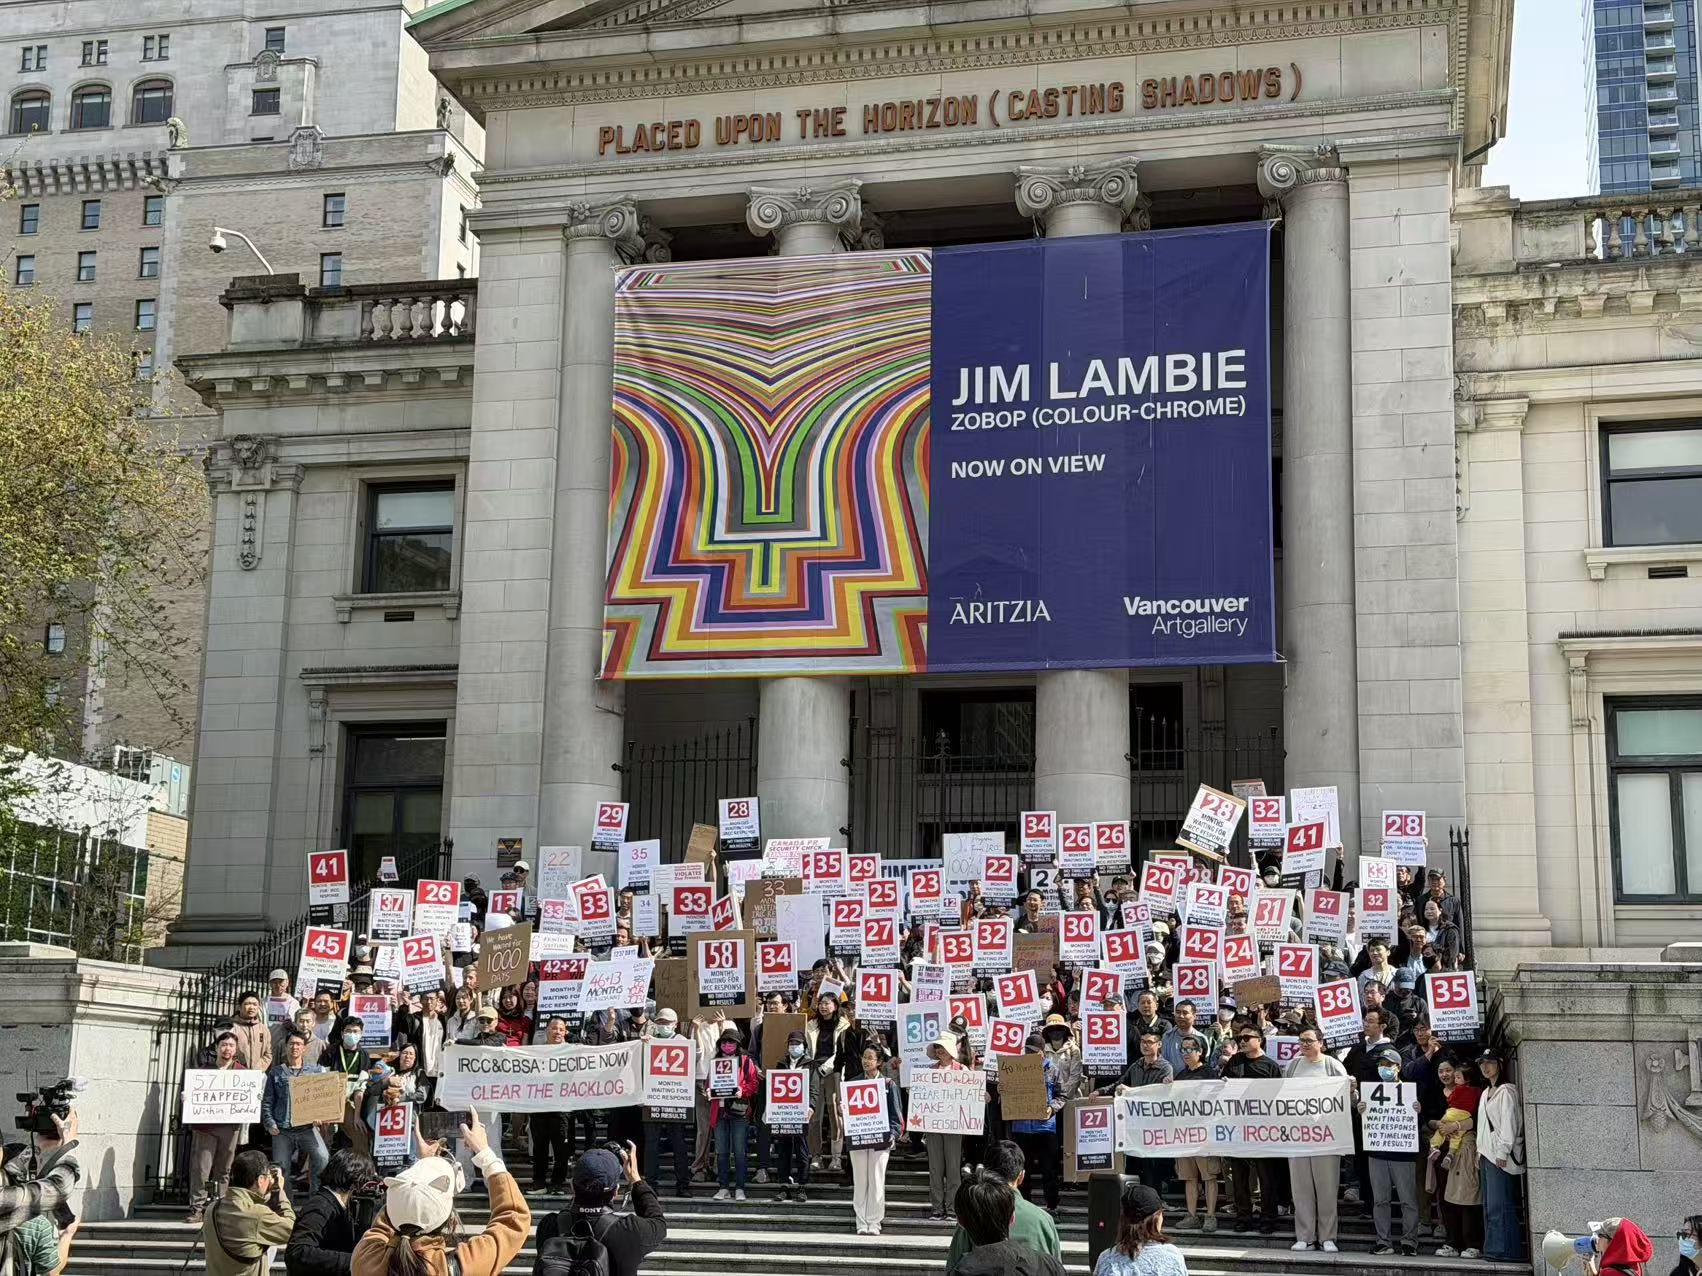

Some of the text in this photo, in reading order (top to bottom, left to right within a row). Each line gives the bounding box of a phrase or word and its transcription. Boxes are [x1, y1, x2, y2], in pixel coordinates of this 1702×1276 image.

[598, 119, 701, 155] PLACED
[715, 112, 782, 145] UPON
[797, 106, 847, 139] THE
[863, 95, 978, 134] HORIZON
[952, 349, 1247, 406] JIM LAMBIE
[951, 395, 1246, 431] ZOBOP (COLOUR-CHROME)
[951, 453, 1106, 479] NOW ON VIEW
[1123, 597, 1249, 616] Vancouver
[1152, 615, 1248, 639] Artgallery
[600, 807, 622, 823] 29
[729, 803, 748, 817] 28
[1204, 795, 1235, 821] 28
[1255, 801, 1280, 818] 32
[1027, 817, 1050, 833] 34
[1192, 818, 1227, 837] WAITING FOR
[1201, 813, 1224, 828] MONTHS
[1387, 816, 1420, 836] 28
[1065, 829, 1089, 847] 26
[1099, 828, 1124, 845] 26
[1293, 827, 1317, 847] 41
[632, 848, 647, 860] 35
[316, 858, 338, 876] 41
[815, 855, 840, 873] 35
[851, 859, 875, 877] 29
[987, 860, 1010, 877] 22
[1369, 864, 1387, 878] 33
[764, 880, 786, 897] 33
[914, 874, 940, 893] 23
[1147, 869, 1173, 889] 20
[1223, 874, 1248, 890] 20
[380, 893, 404, 911] 37
[425, 884, 452, 901] 26
[680, 893, 707, 911] 33
[870, 884, 896, 902] 25
[944, 898, 956, 906] 12
[1198, 891, 1220, 905] 24
[1368, 895, 1383, 906] 32
[543, 905, 564, 919] 33
[583, 895, 608, 915] 33
[714, 901, 732, 923] 44
[1255, 899, 1285, 926] 31
[1319, 897, 1334, 909] 27
[837, 904, 861, 922] 22
[1126, 906, 1149, 923] 36
[867, 922, 892, 942] 27
[980, 925, 1005, 945] 32
[1066, 918, 1092, 937] 30
[311, 934, 340, 955] 45
[405, 939, 434, 962] 25
[945, 938, 971, 957] 33
[1108, 935, 1134, 957] 31
[1187, 932, 1216, 953] 42
[1225, 940, 1252, 962] 24
[487, 947, 522, 973] 1000
[709, 942, 733, 968] 58
[763, 947, 791, 968] 34
[1281, 950, 1311, 971] 27
[543, 960, 585, 973] 42+21
[545, 972, 558, 980] PR
[491, 972, 511, 984] DAYS
[863, 976, 887, 997] 41
[1088, 977, 1113, 997] 21
[1180, 969, 1207, 990] 28
[586, 985, 624, 997] MONTHS
[1002, 977, 1029, 1001] 31
[1435, 979, 1467, 1003] 35
[363, 1002, 378, 1012] 44
[1322, 987, 1351, 1011] 38
[952, 1000, 977, 1020] 21
[907, 1020, 940, 1042] 38
[1090, 1018, 1119, 1038] 33
[993, 1025, 1022, 1051] 39
[1336, 1034, 1358, 1042] TIMELINE
[1336, 1039, 1360, 1047] RESULTS
[458, 1052, 629, 1074] IRCC&CBSA: DECIDE NOW
[653, 1048, 685, 1073] 42
[716, 1061, 732, 1073] 42
[1001, 1062, 1014, 1074] 40
[233, 1074, 257, 1088] Days
[773, 1076, 801, 1097] 59
[912, 1071, 985, 1089] IRCC END Delay
[194, 1091, 248, 1102] TRAPPED
[471, 1079, 624, 1101] CLEAR THE BACKLOG
[849, 1087, 877, 1109] 40
[954, 1088, 985, 1103] PLATE
[1370, 1083, 1404, 1106] 41
[911, 1102, 945, 1113] MAKE
[1277, 1095, 1344, 1116] DECISION
[380, 1108, 404, 1129] 43
[1085, 1113, 1102, 1125] 27
[1142, 1124, 1335, 1146] DELAYED BY IRCC&CBSA
